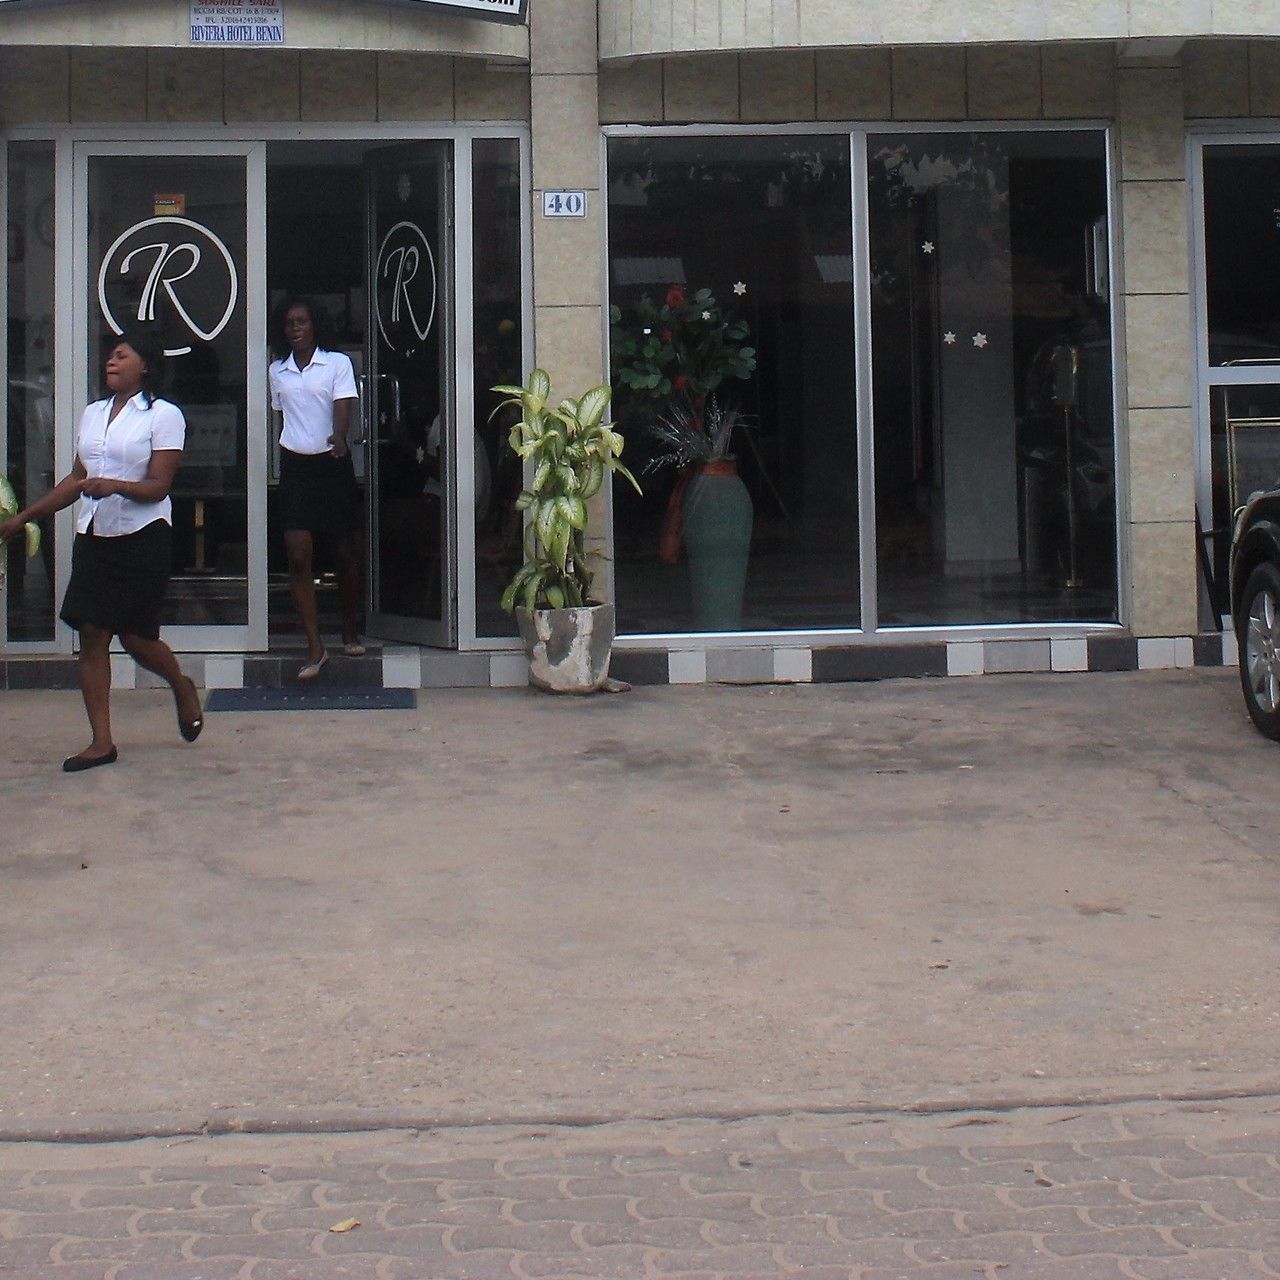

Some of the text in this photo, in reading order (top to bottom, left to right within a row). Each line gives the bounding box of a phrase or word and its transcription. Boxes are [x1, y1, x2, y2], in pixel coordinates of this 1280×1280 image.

[191, 25, 282, 41] RIVIERA HOTEL BENIN
[548, 194, 582, 213] 40
